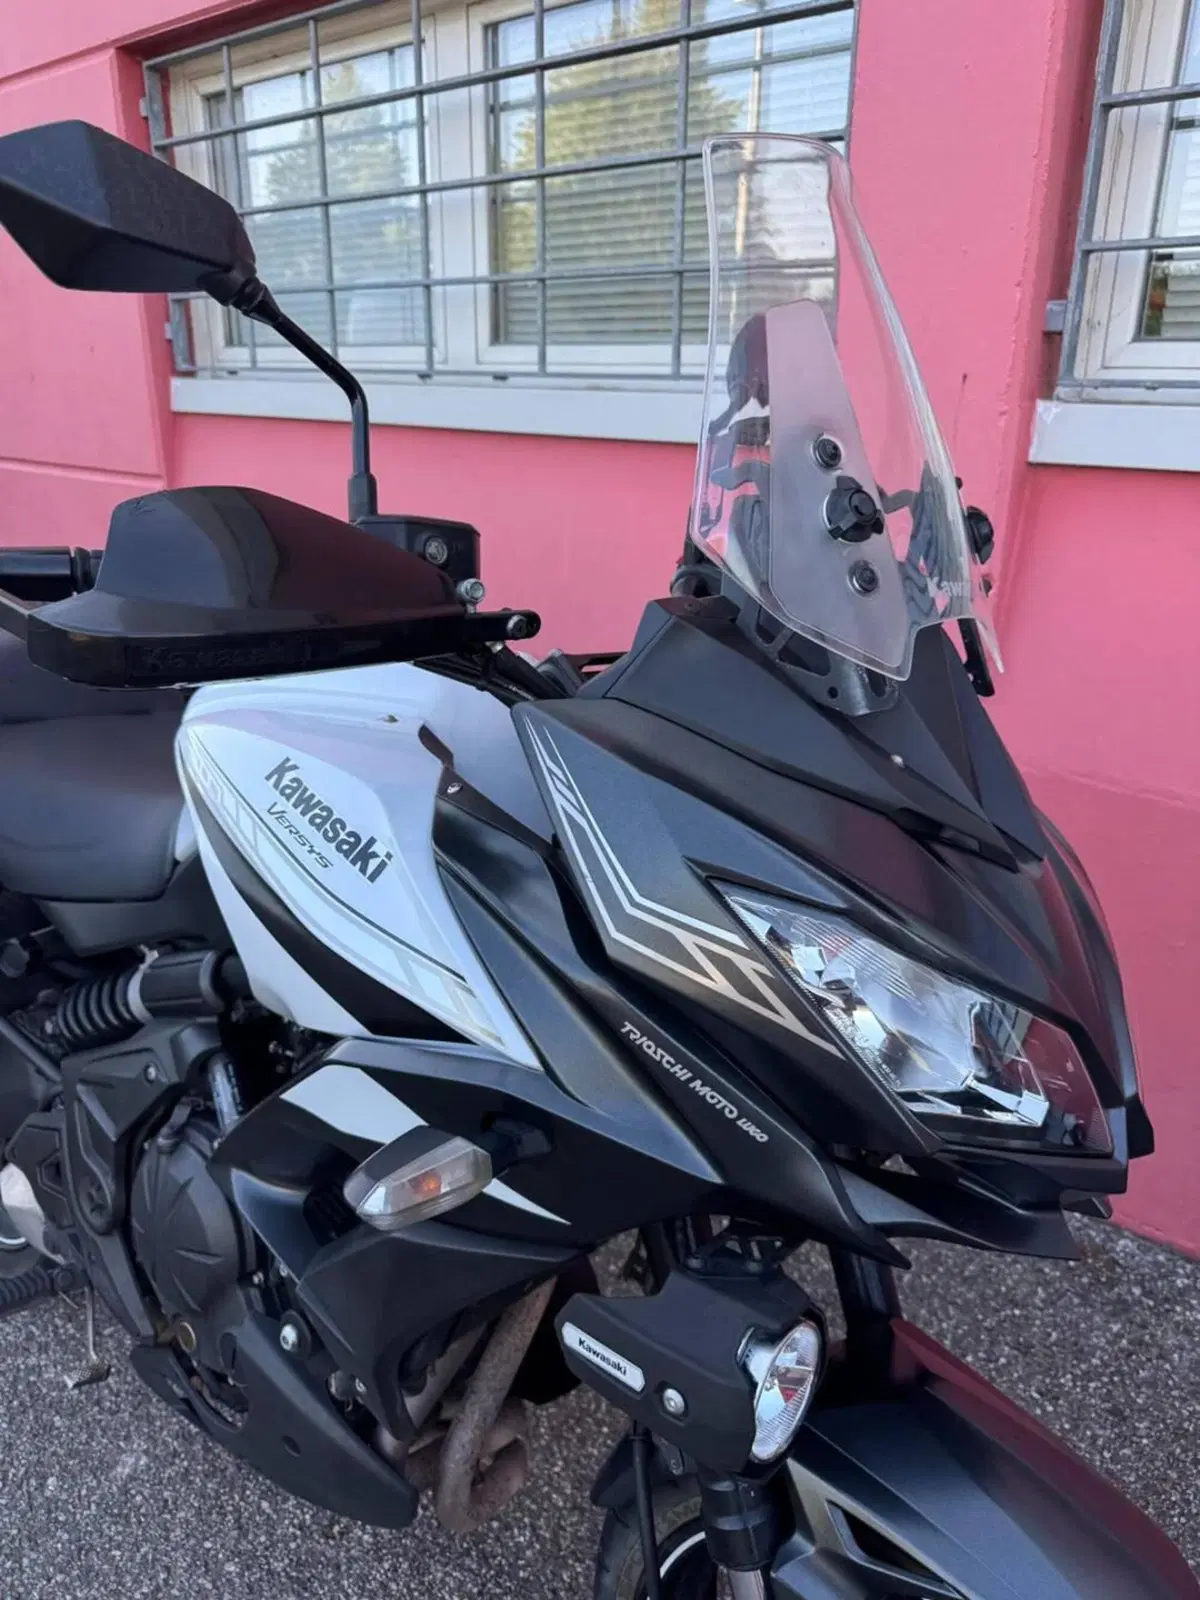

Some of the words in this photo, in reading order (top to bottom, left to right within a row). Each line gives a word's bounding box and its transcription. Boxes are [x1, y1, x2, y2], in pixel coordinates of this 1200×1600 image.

[264, 756, 393, 884] Kawasaki
[267, 801, 334, 869] VERSYS
[688, 1078, 739, 1119] MOTO
[578, 1336, 627, 1376] Kawasaki
